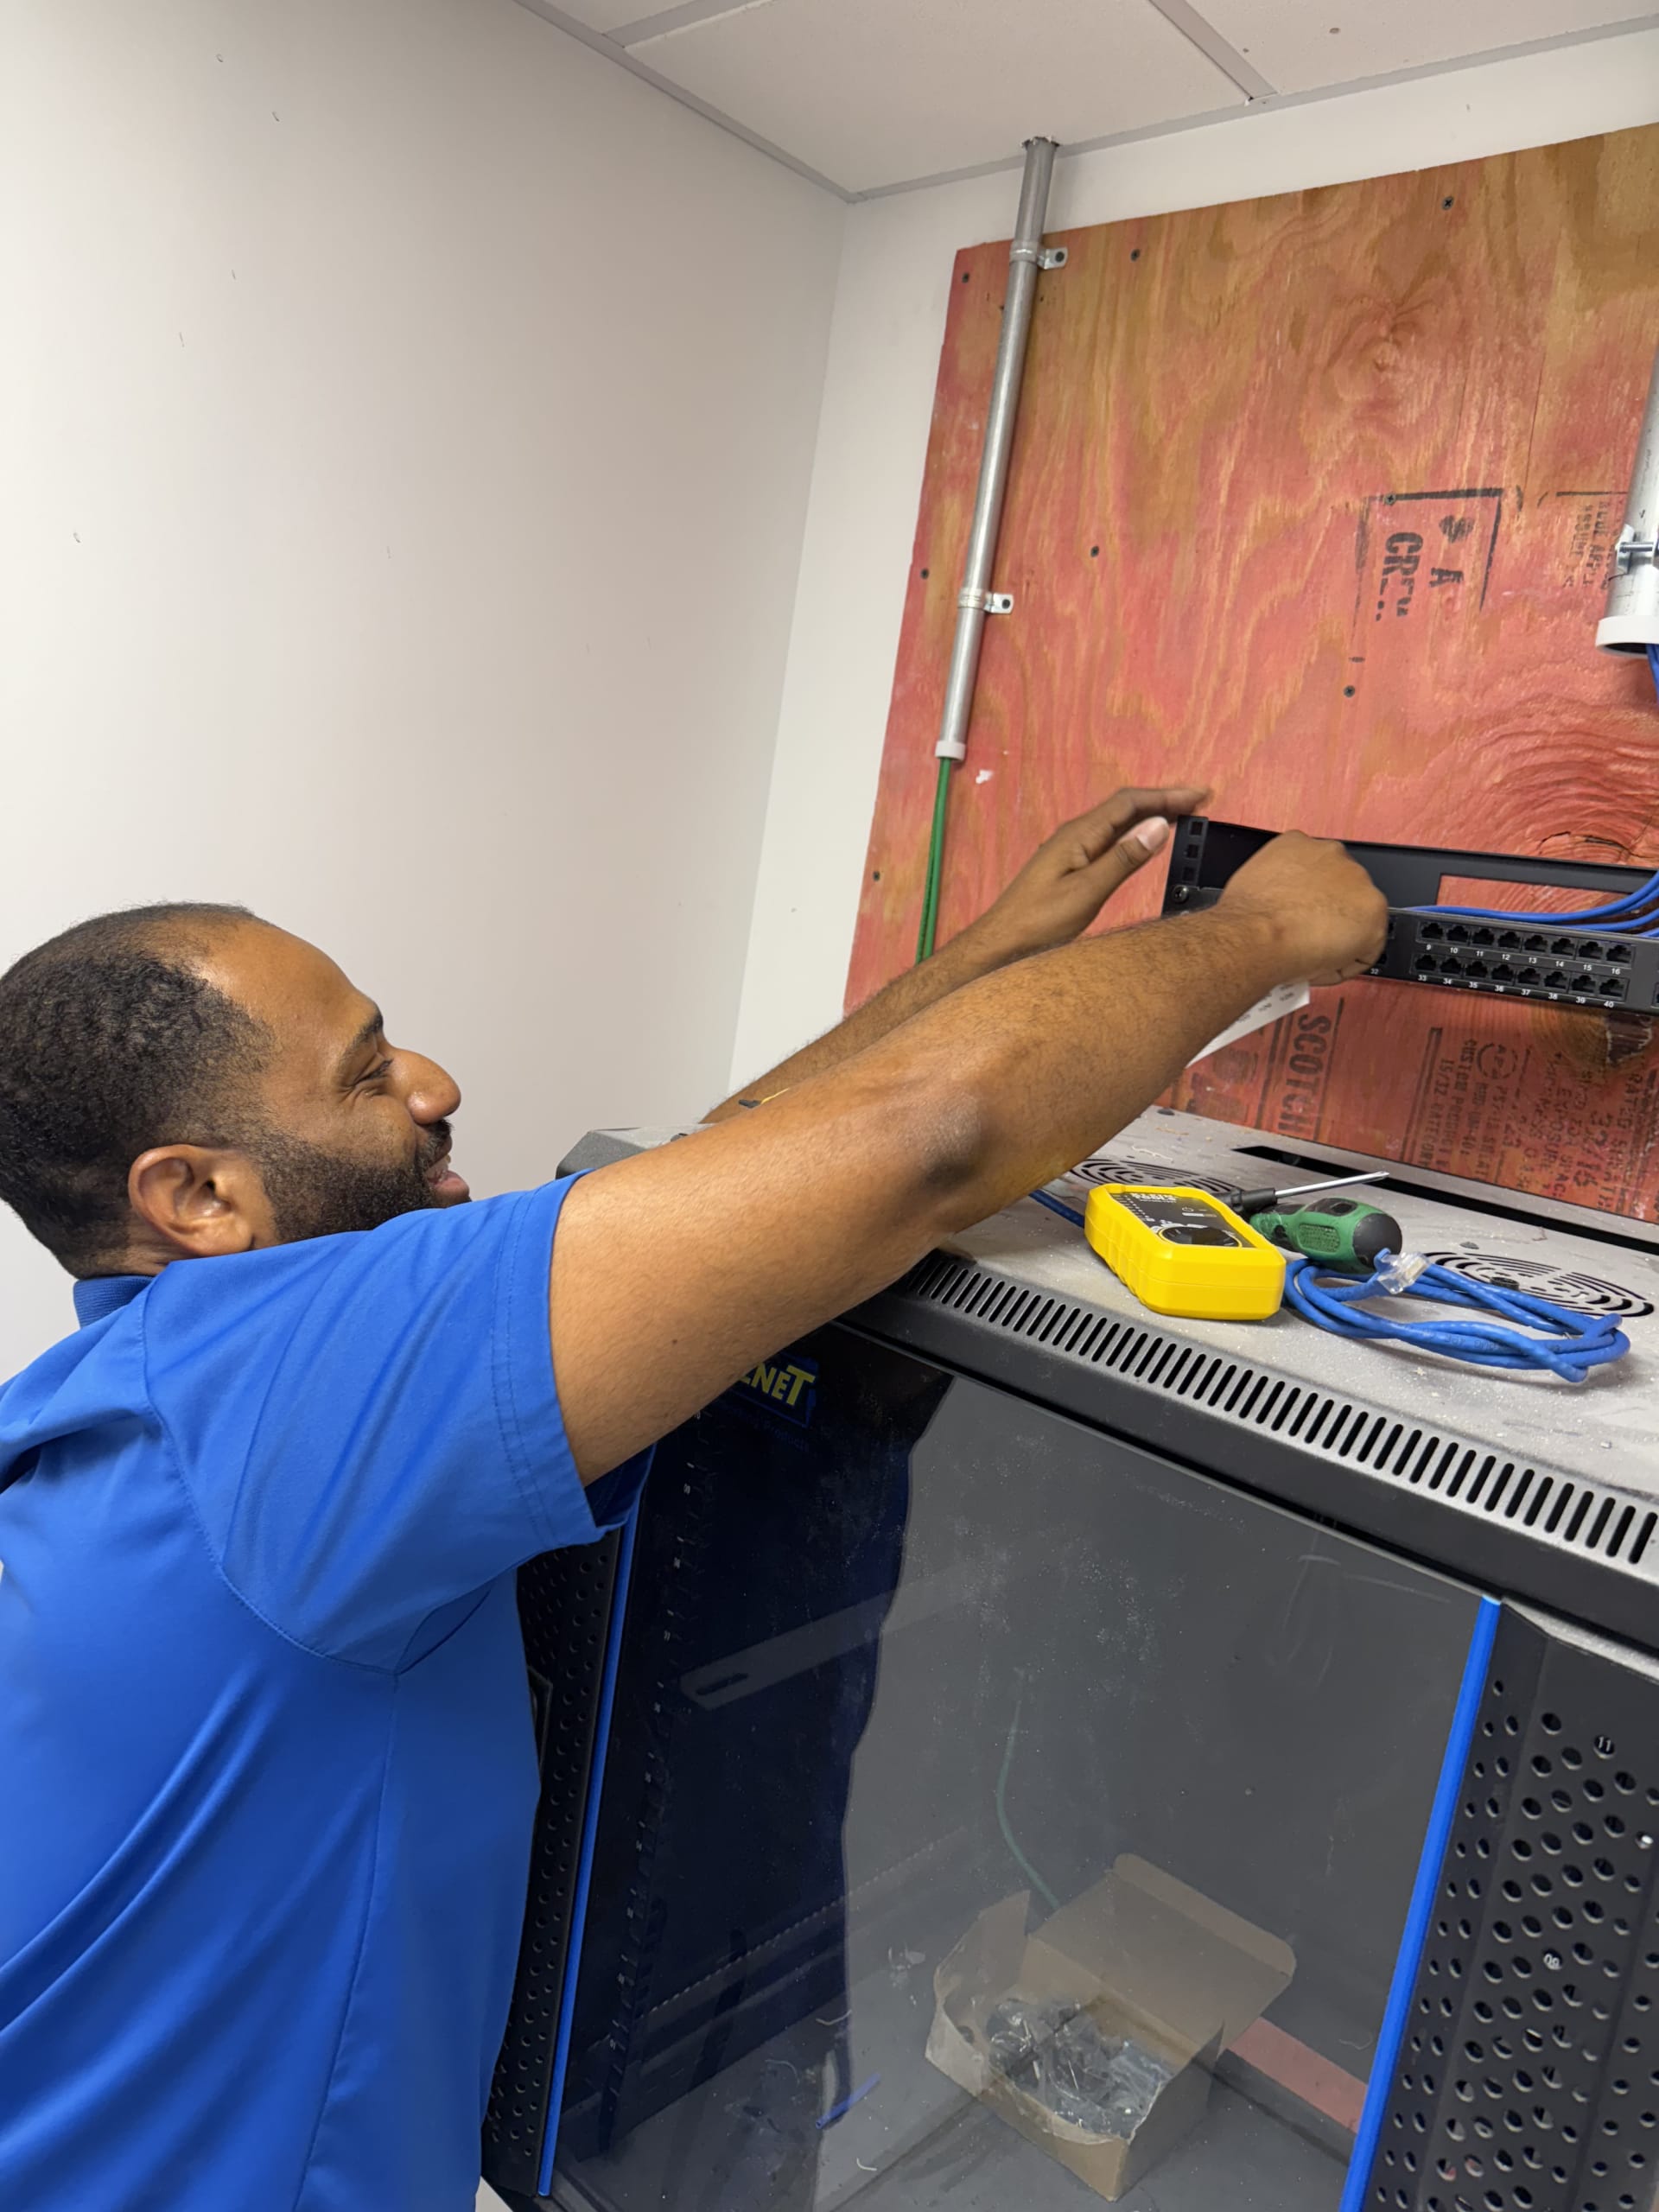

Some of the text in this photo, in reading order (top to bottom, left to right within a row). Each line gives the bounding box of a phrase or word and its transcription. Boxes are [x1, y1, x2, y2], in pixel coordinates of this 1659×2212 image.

[1277, 1014, 1332, 1131] SCOTCH
[1433, 1058, 1455, 1096] 15/32
[739, 1361, 816, 1406] NET
